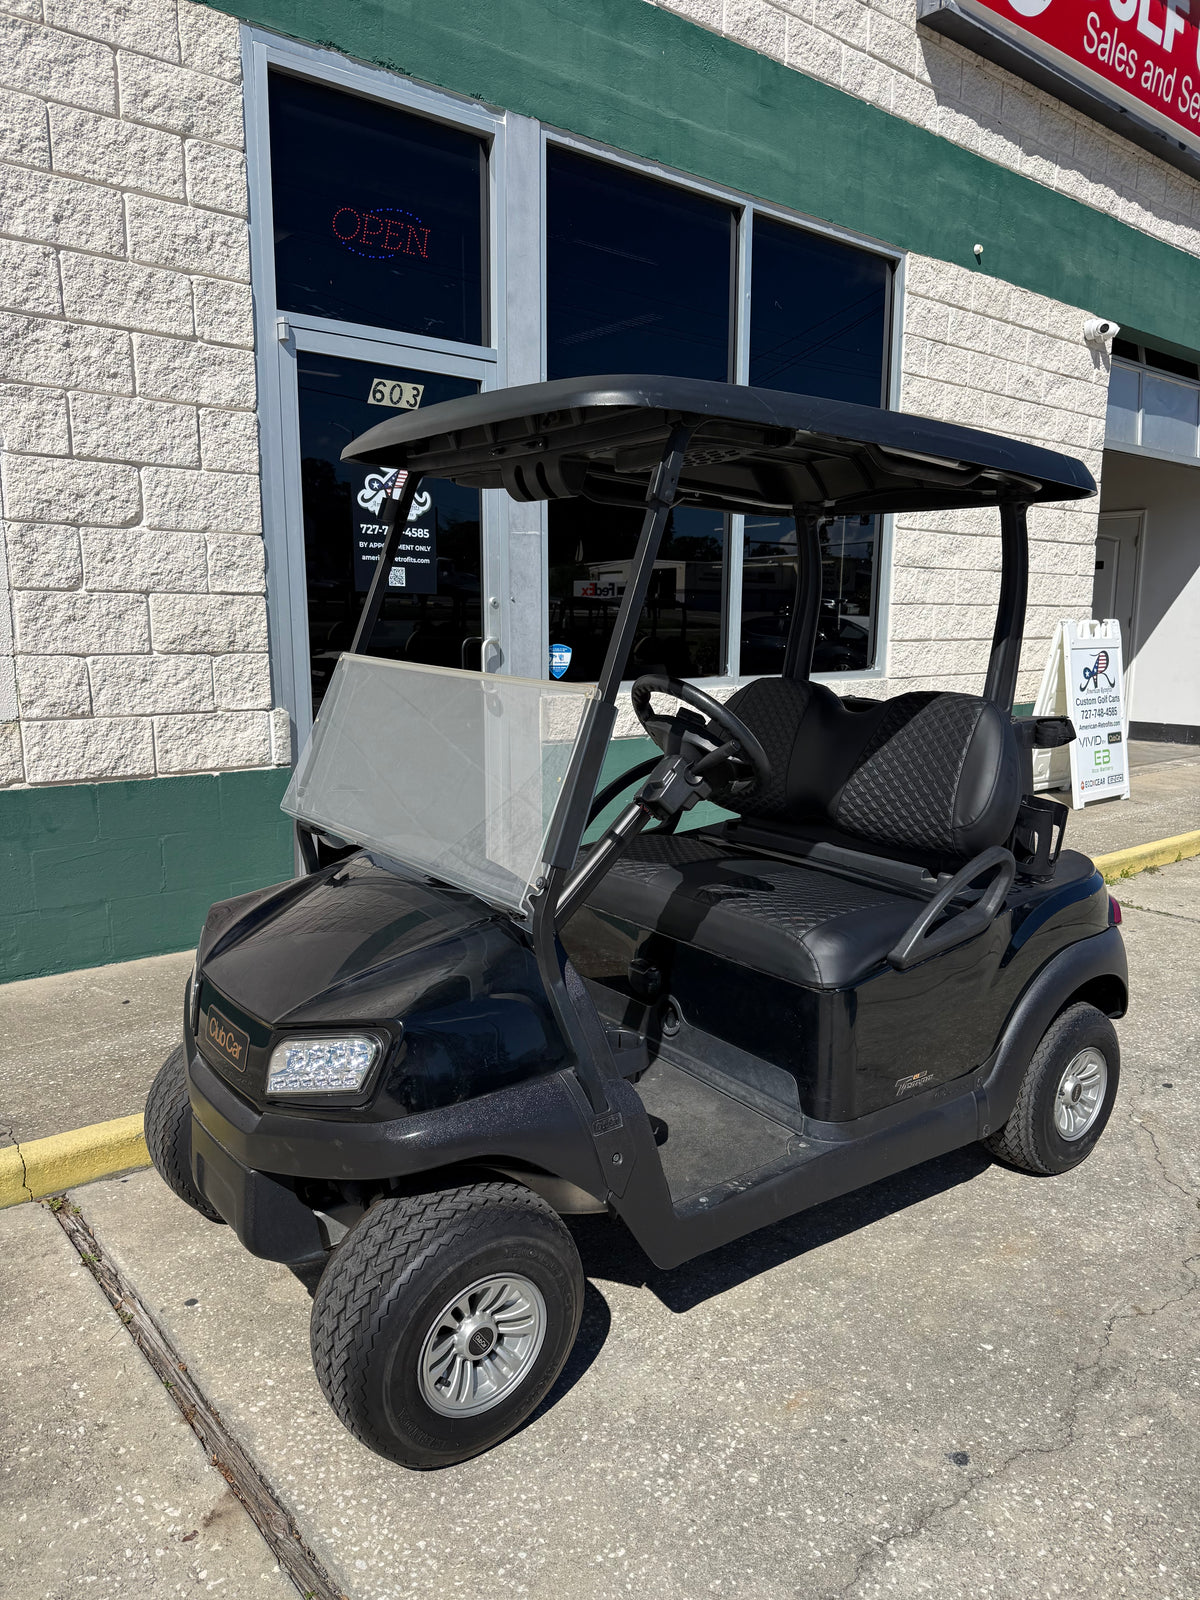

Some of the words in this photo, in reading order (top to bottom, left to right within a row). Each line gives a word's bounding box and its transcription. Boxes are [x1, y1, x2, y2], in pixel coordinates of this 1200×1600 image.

[1083, 11, 1138, 79] Sales
[1140, 60, 1178, 103] and
[1178, 75, 1200, 122] Se
[332, 207, 431, 258] OPEN
[372, 381, 421, 408] 603
[360, 524, 430, 539] 727-7-4585
[1075, 697, 1096, 706] Custom
[1097, 695, 1108, 704] Golf
[1081, 707, 1118, 720] 727-748-4585
[1094, 748, 1111, 766] EB
[210, 1017, 226, 1047] Club
[226, 1032, 242, 1060] Car
